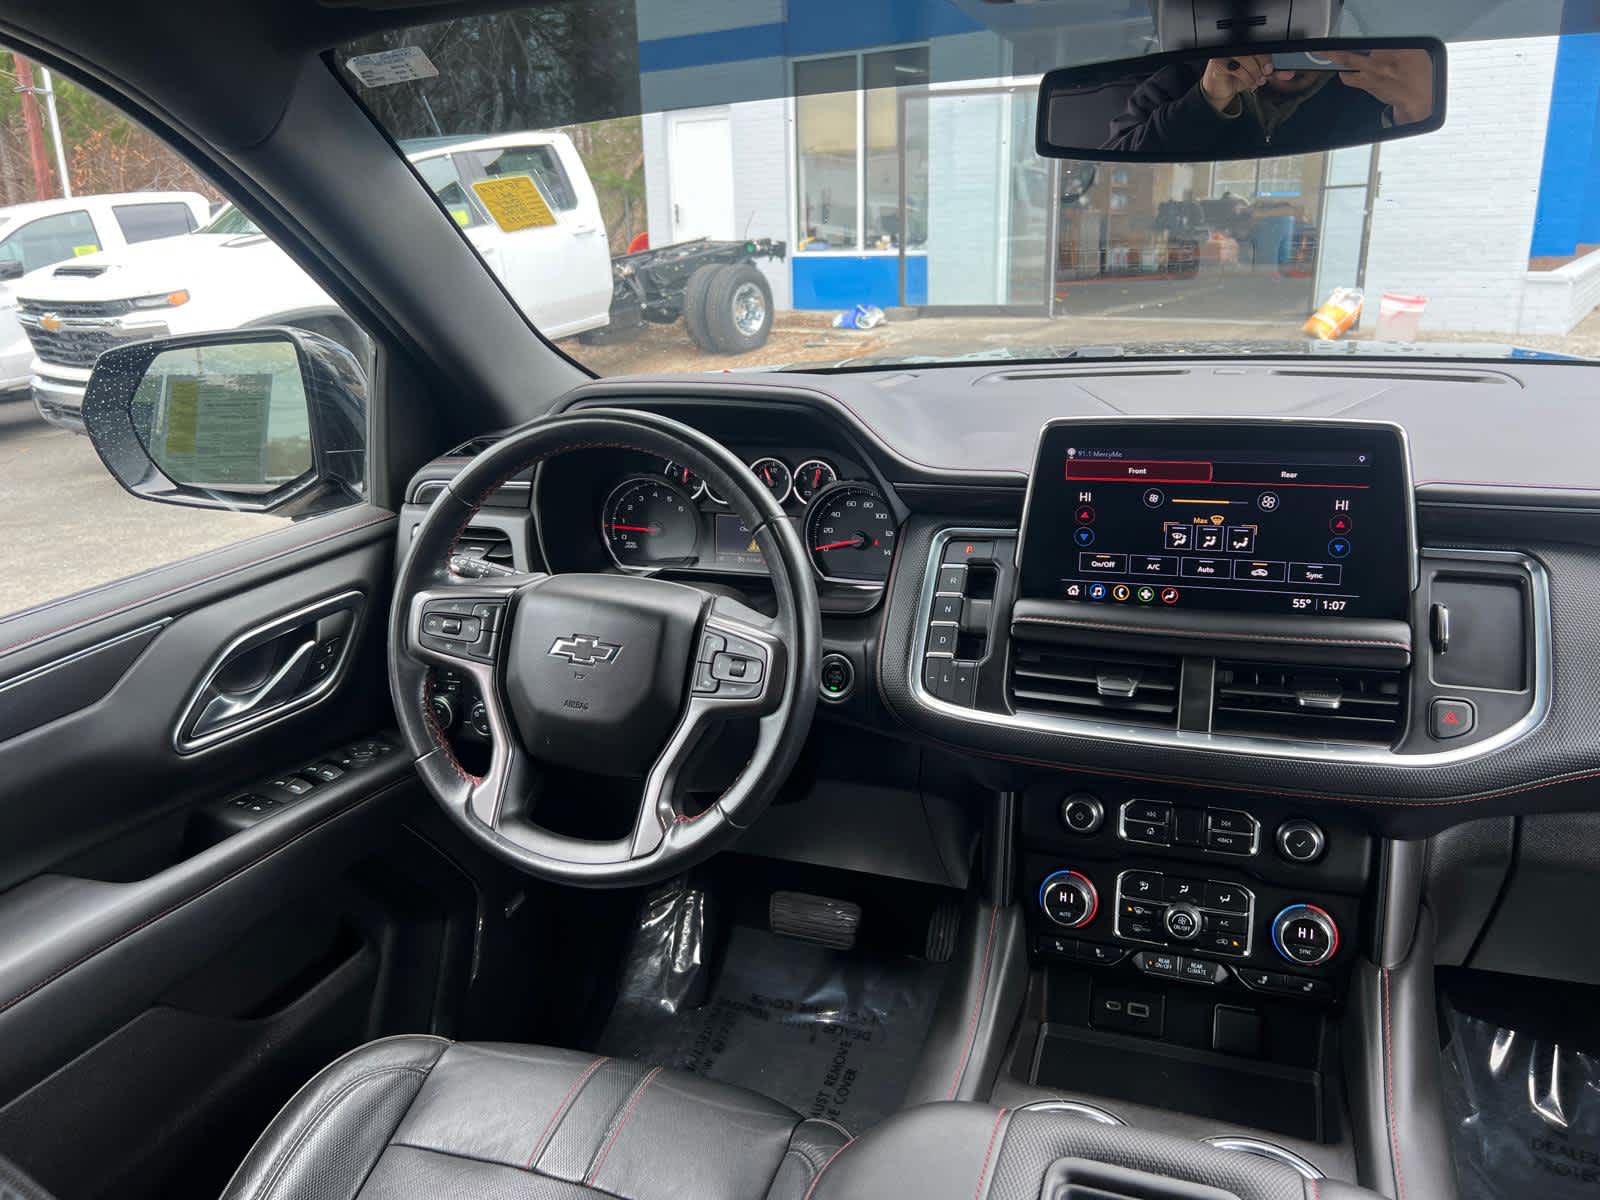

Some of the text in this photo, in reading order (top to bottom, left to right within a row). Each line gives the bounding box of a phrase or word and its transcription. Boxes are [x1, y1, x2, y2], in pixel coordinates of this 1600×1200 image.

[1128, 467, 1147, 475] Front
[1280, 471, 1298, 479] Rear
[1079, 491, 1092, 502] HI
[1335, 500, 1349, 511] HI
[1193, 516, 1208, 525] Max
[966, 544, 975, 554] P
[1091, 559, 1116, 569] On/Off
[1147, 563, 1161, 571] A/C
[1197, 566, 1215, 574] Auto
[1305, 571, 1324, 581] Sync
[944, 605, 952, 613] N
[1322, 600, 1346, 611] 1:07
[939, 636, 946, 644] D
[1059, 891, 1074, 904] HI
[1298, 927, 1314, 940] HI
